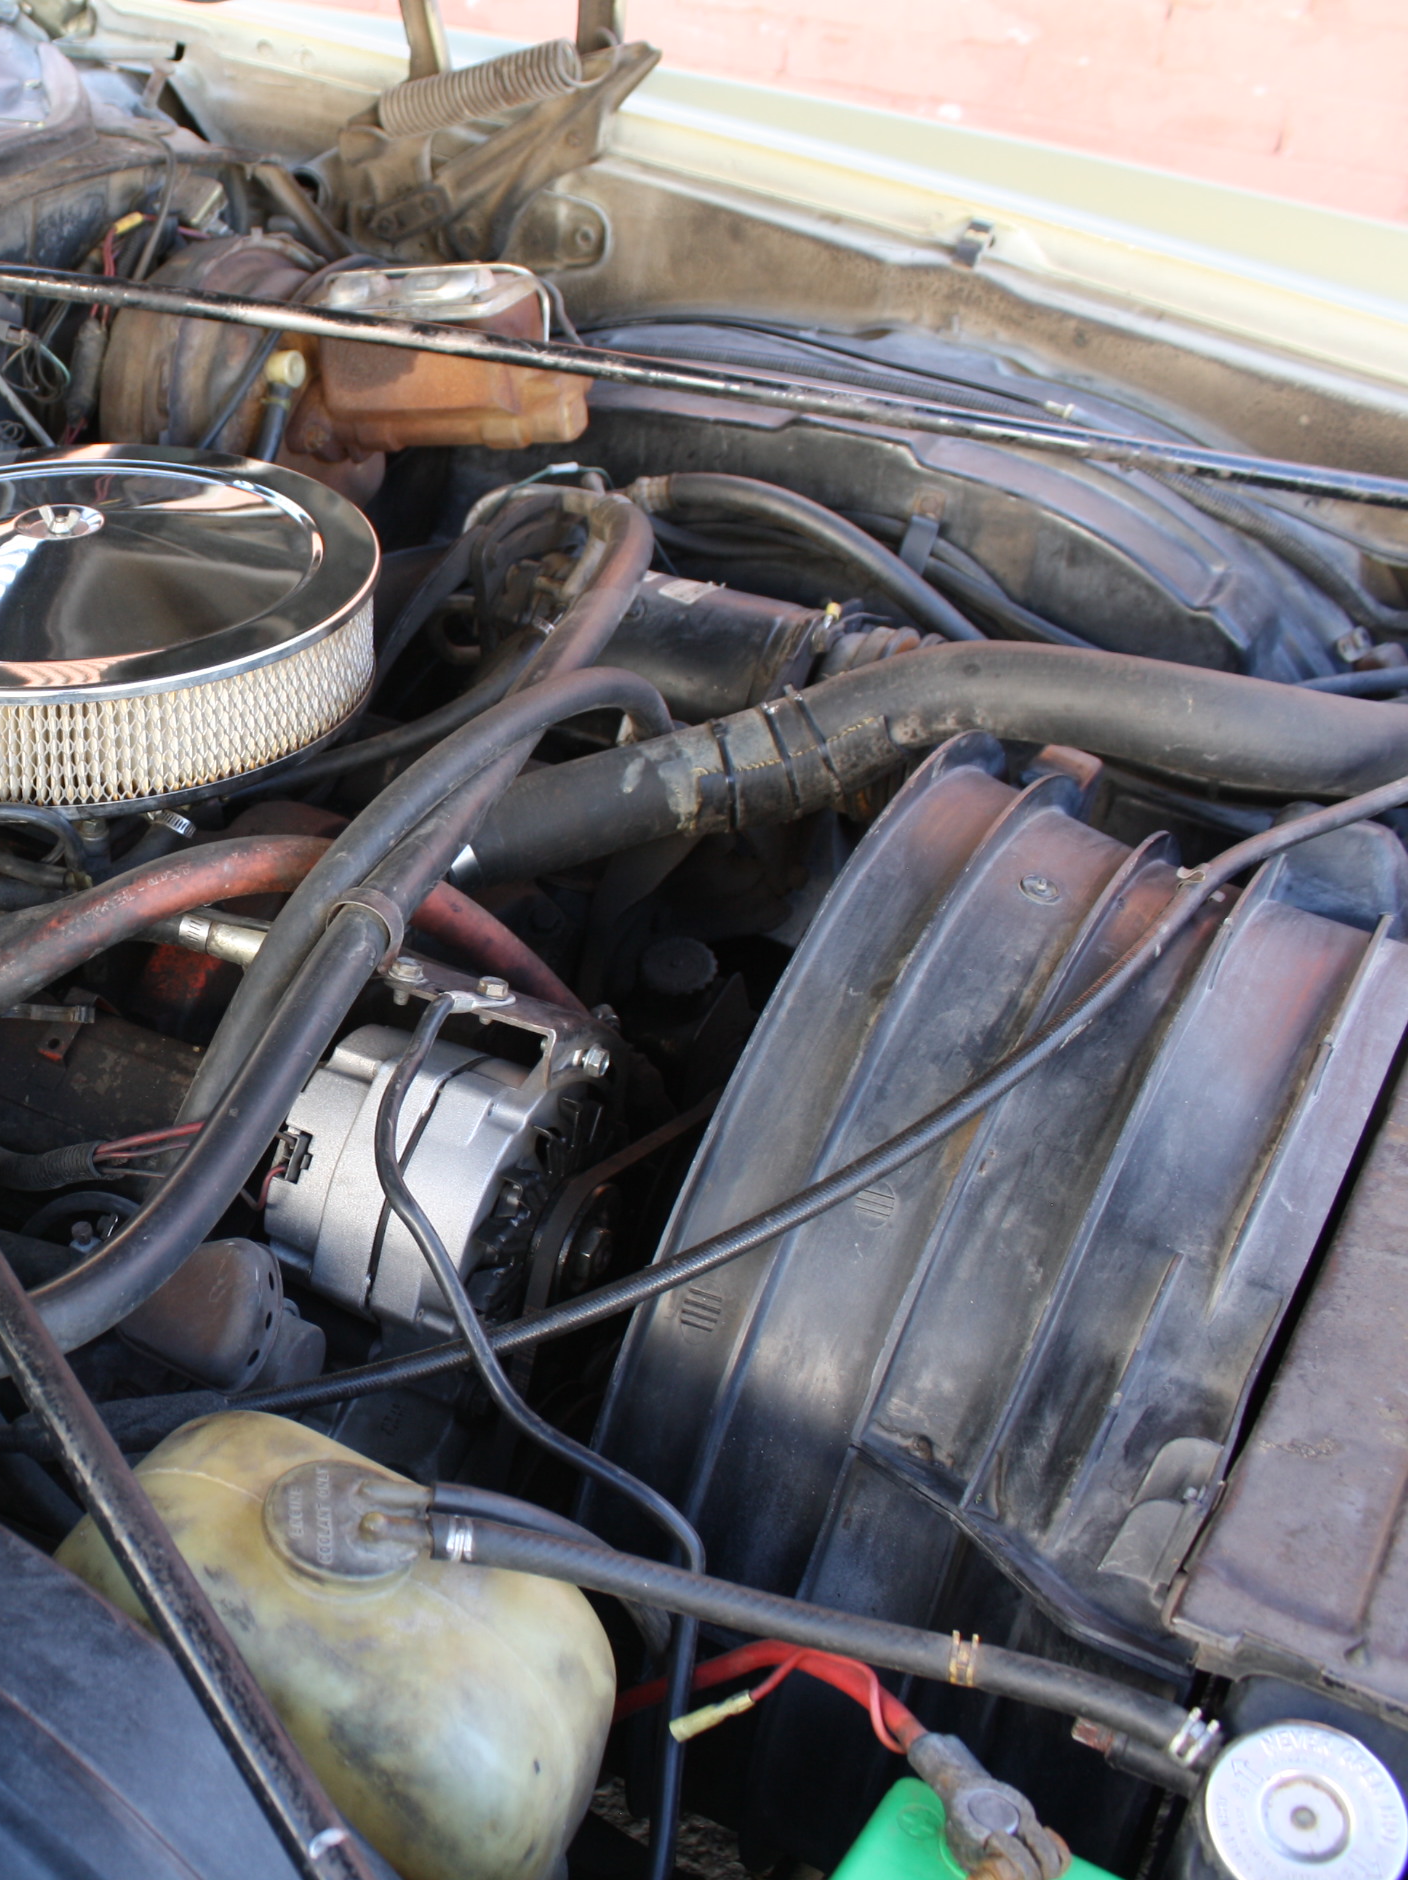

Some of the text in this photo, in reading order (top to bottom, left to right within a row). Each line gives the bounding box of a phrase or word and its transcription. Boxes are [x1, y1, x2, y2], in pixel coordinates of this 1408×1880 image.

[288, 1485, 304, 1538] ENGINE
[314, 1466, 334, 1565] COOLANT ONLY
[1259, 1730, 1333, 1757] NEVER
